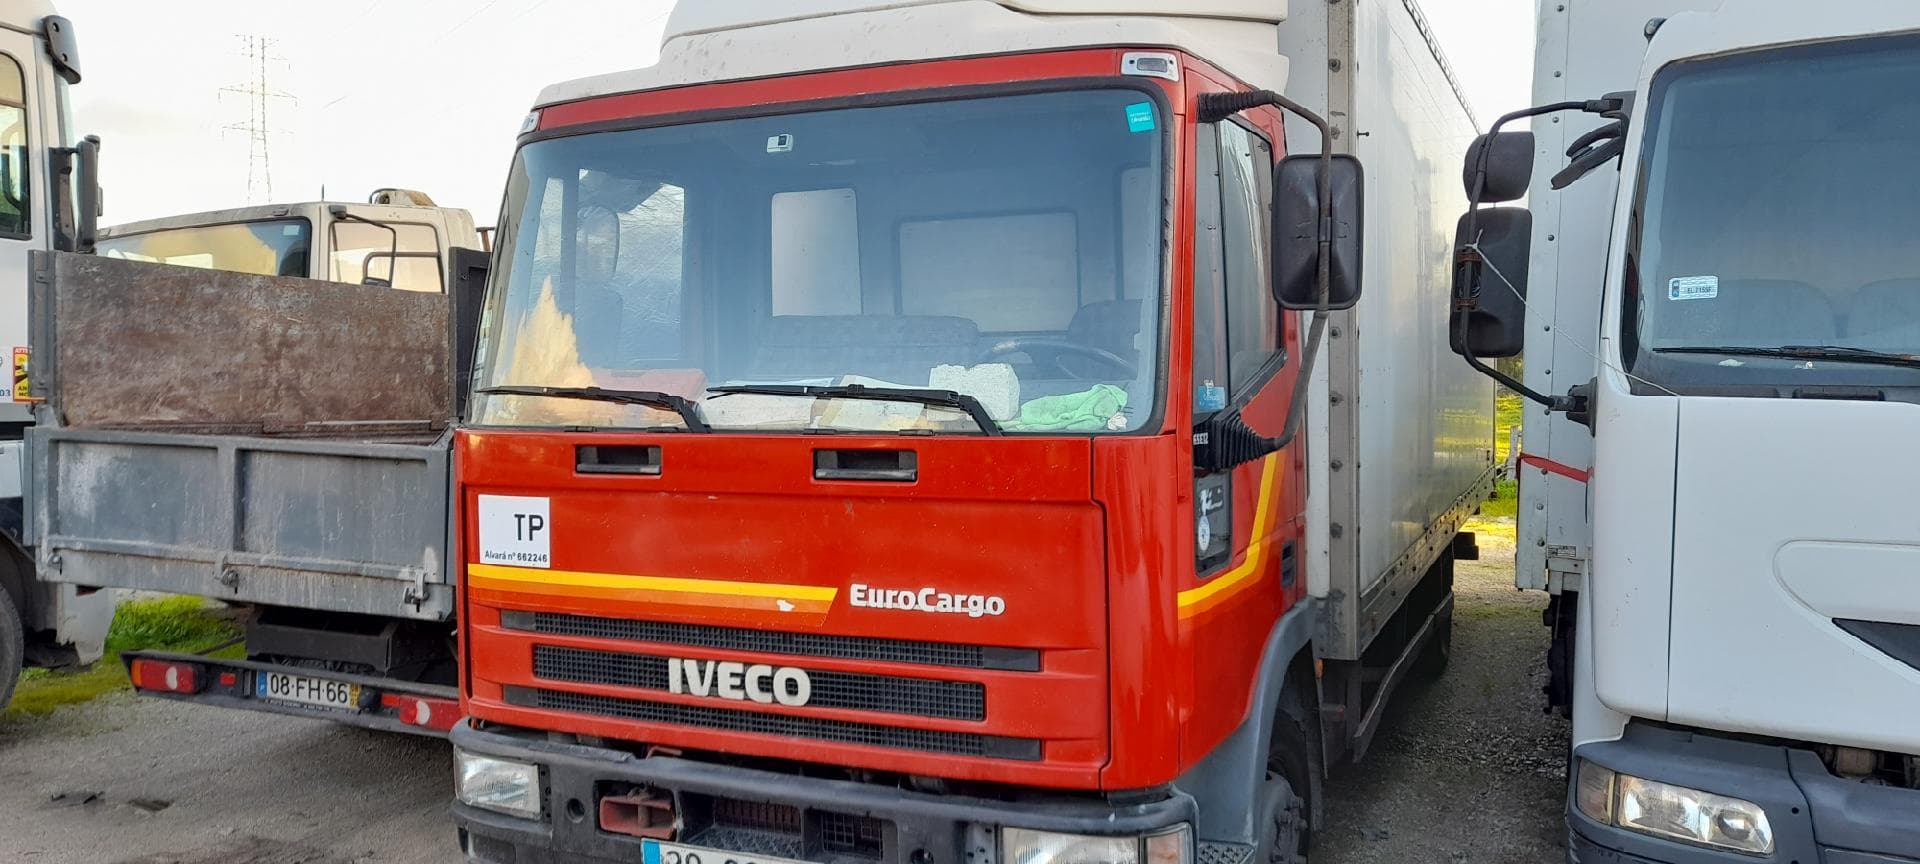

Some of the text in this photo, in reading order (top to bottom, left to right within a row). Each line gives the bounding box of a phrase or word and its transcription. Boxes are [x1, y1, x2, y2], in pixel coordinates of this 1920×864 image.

[514, 513, 544, 541] TP
[484, 550, 507, 561] Alvará
[517, 553, 547, 563] 662246
[850, 584, 1006, 617] EuroCargo
[668, 657, 811, 706] IVECO
